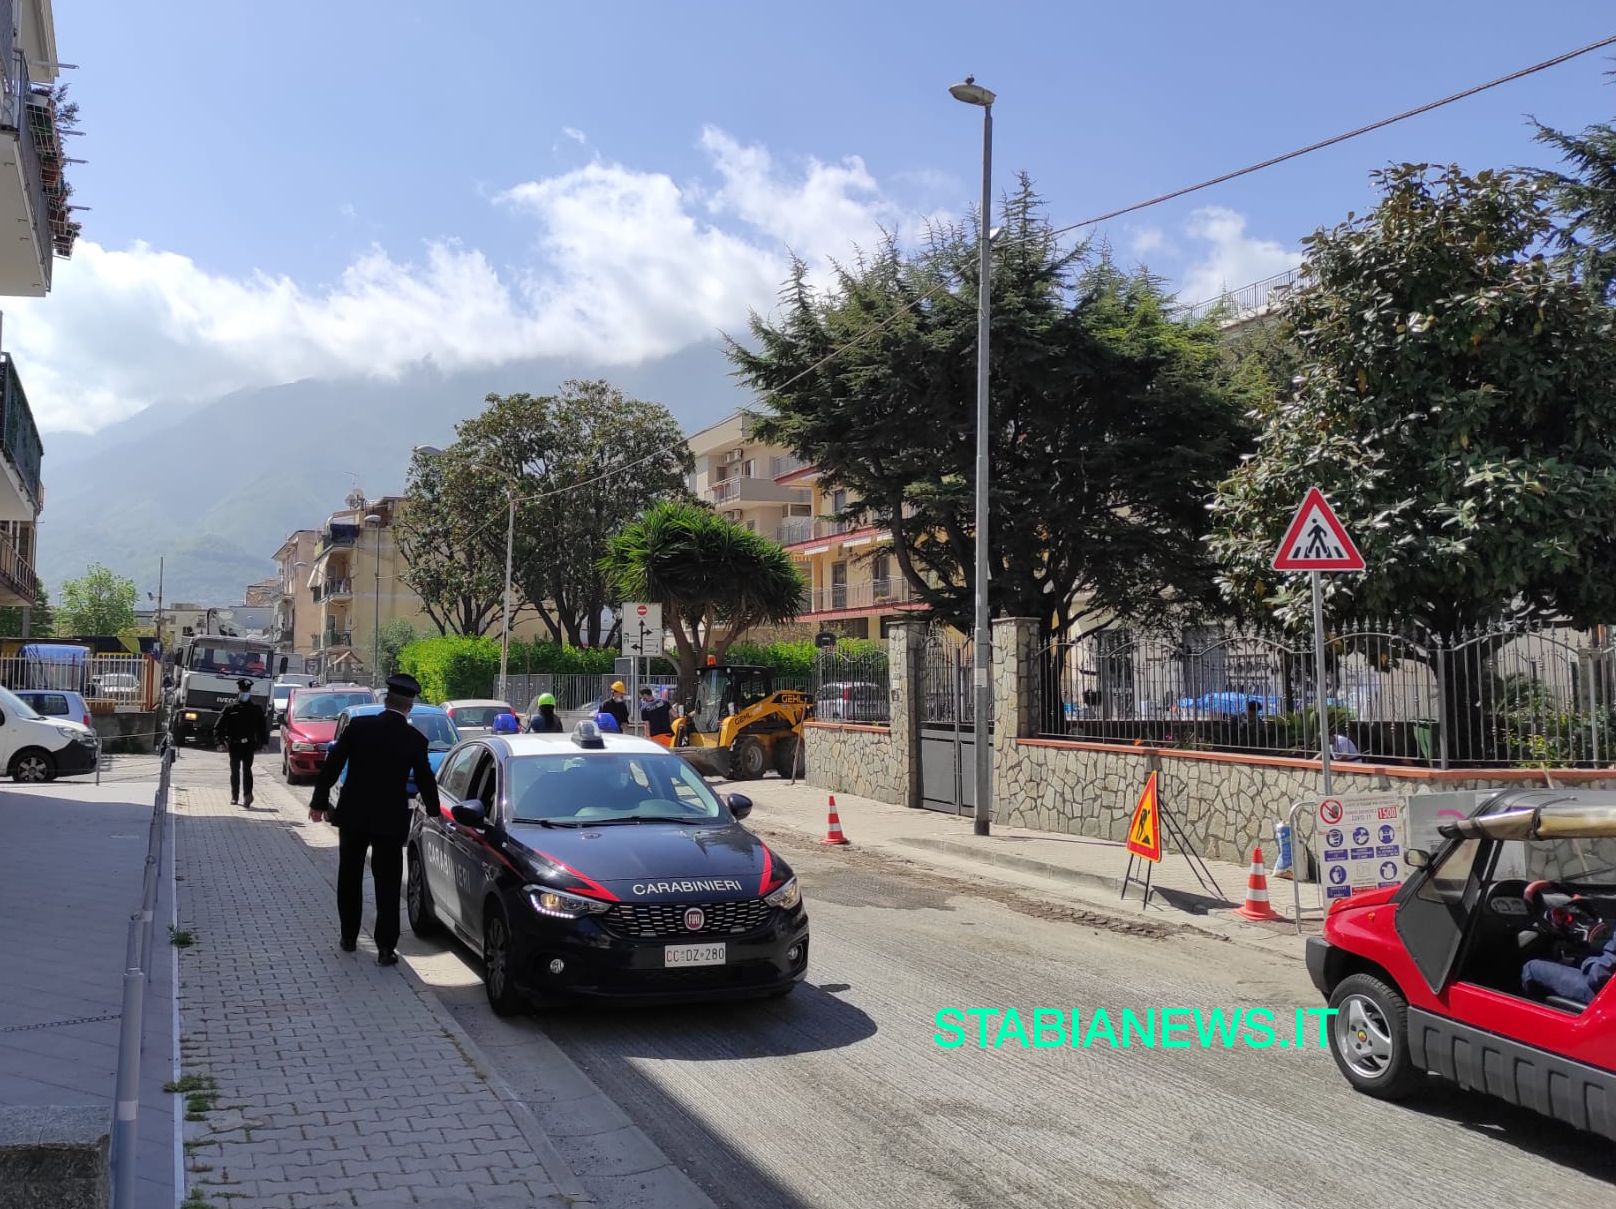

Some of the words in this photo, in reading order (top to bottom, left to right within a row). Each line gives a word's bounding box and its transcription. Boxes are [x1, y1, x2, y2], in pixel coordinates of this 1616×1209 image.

[734, 712, 753, 726] GEHL
[427, 841, 471, 894] CARABINIERI
[632, 880, 743, 895] CARABINIERI
[666, 950, 679, 963] CC
[686, 949, 699, 961] DZ
[706, 947, 725, 961] 280
